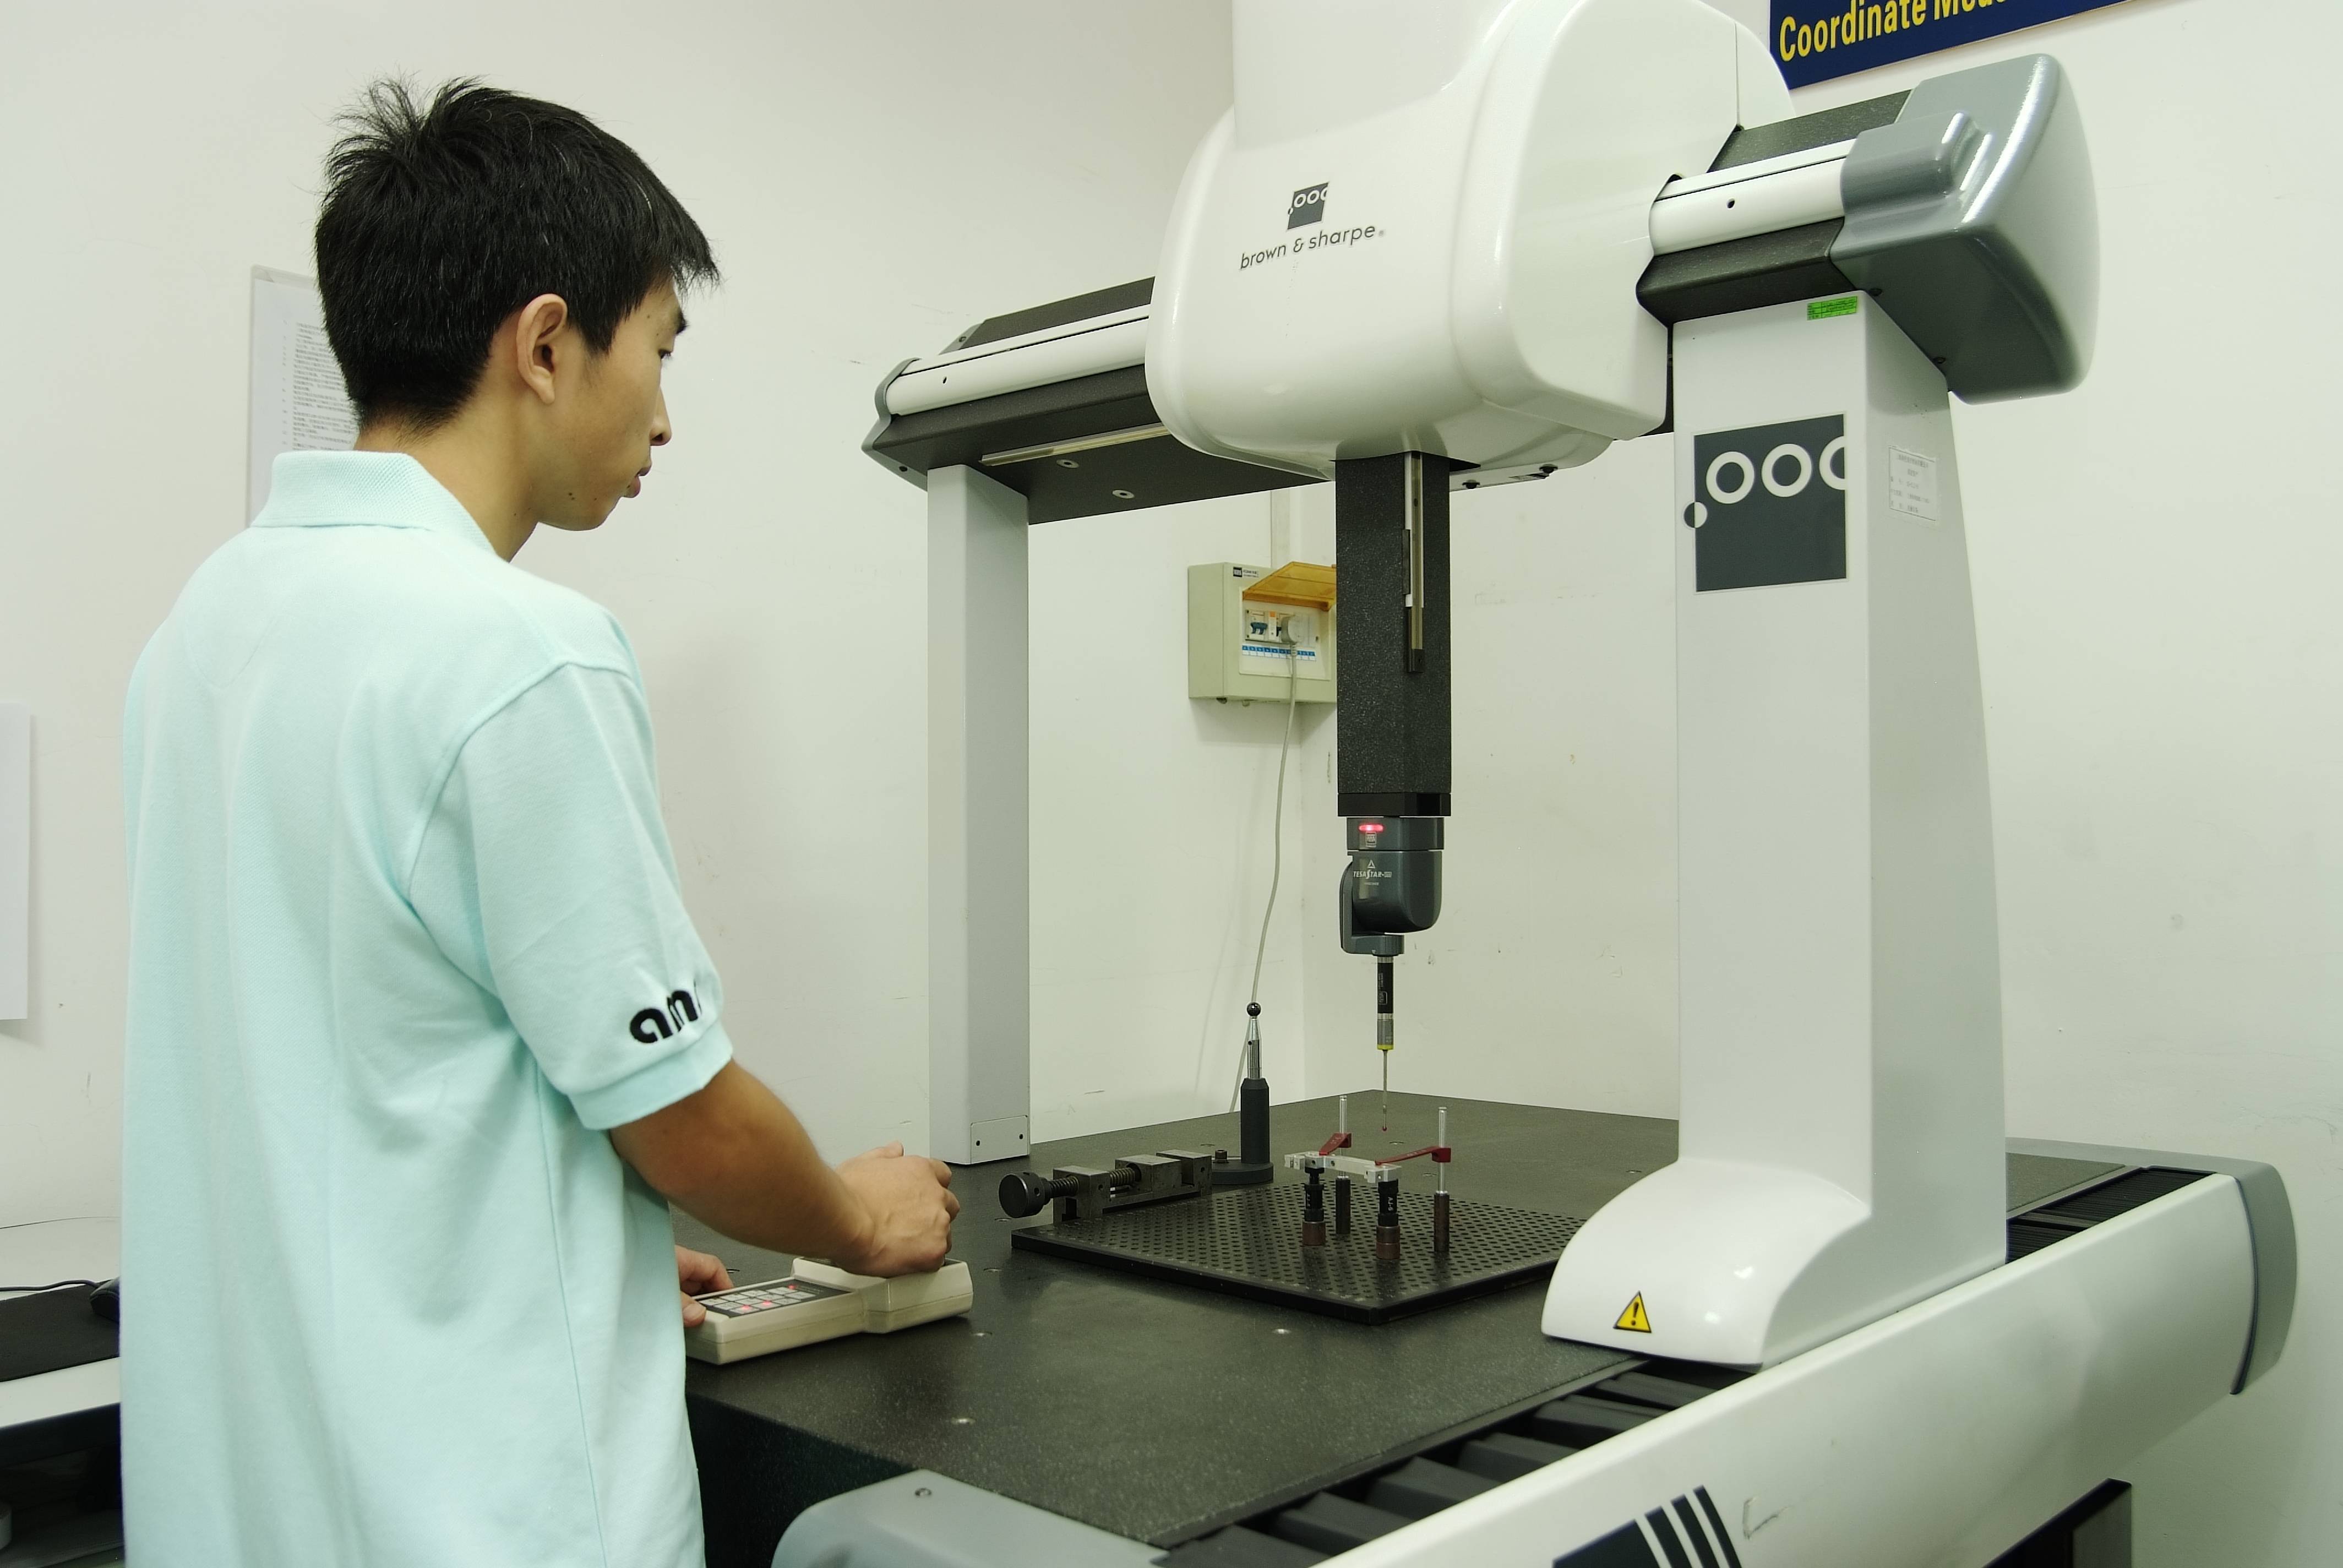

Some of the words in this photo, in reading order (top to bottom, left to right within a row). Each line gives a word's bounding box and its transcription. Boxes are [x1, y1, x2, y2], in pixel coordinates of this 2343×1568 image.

[1779, 0, 1926, 62] Coordinate
[1240, 244, 1287, 269] brown
[1293, 238, 1304, 253] &
